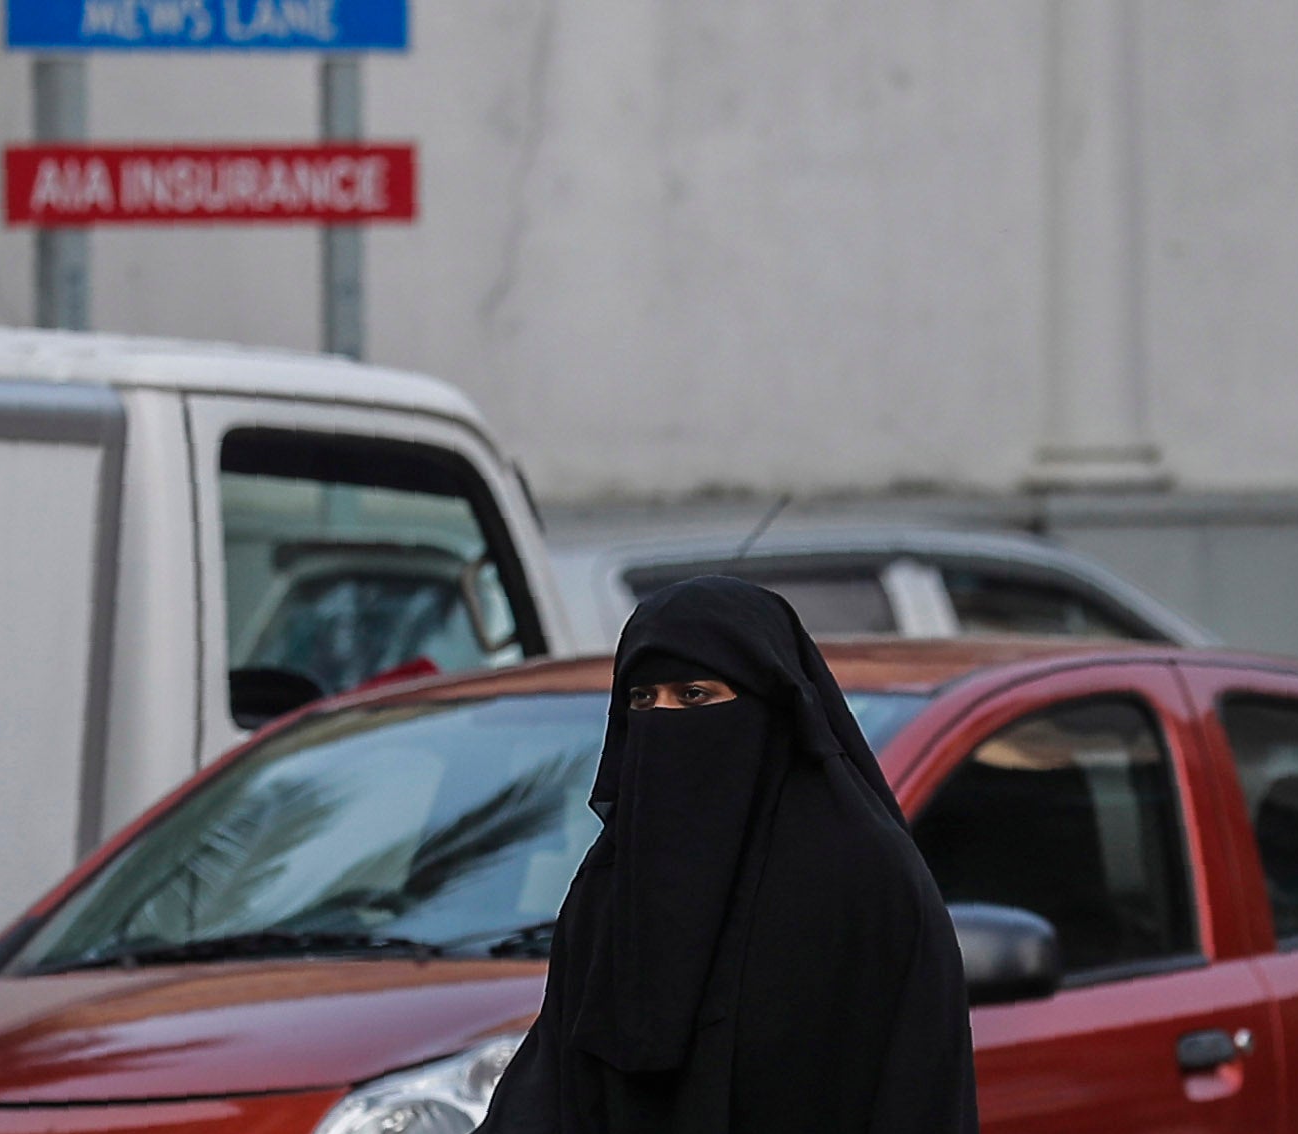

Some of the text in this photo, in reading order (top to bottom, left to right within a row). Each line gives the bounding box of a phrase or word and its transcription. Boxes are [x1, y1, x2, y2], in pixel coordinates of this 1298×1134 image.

[224, 0, 340, 41] LANE
[29, 155, 392, 213] AIA INSURANCE
